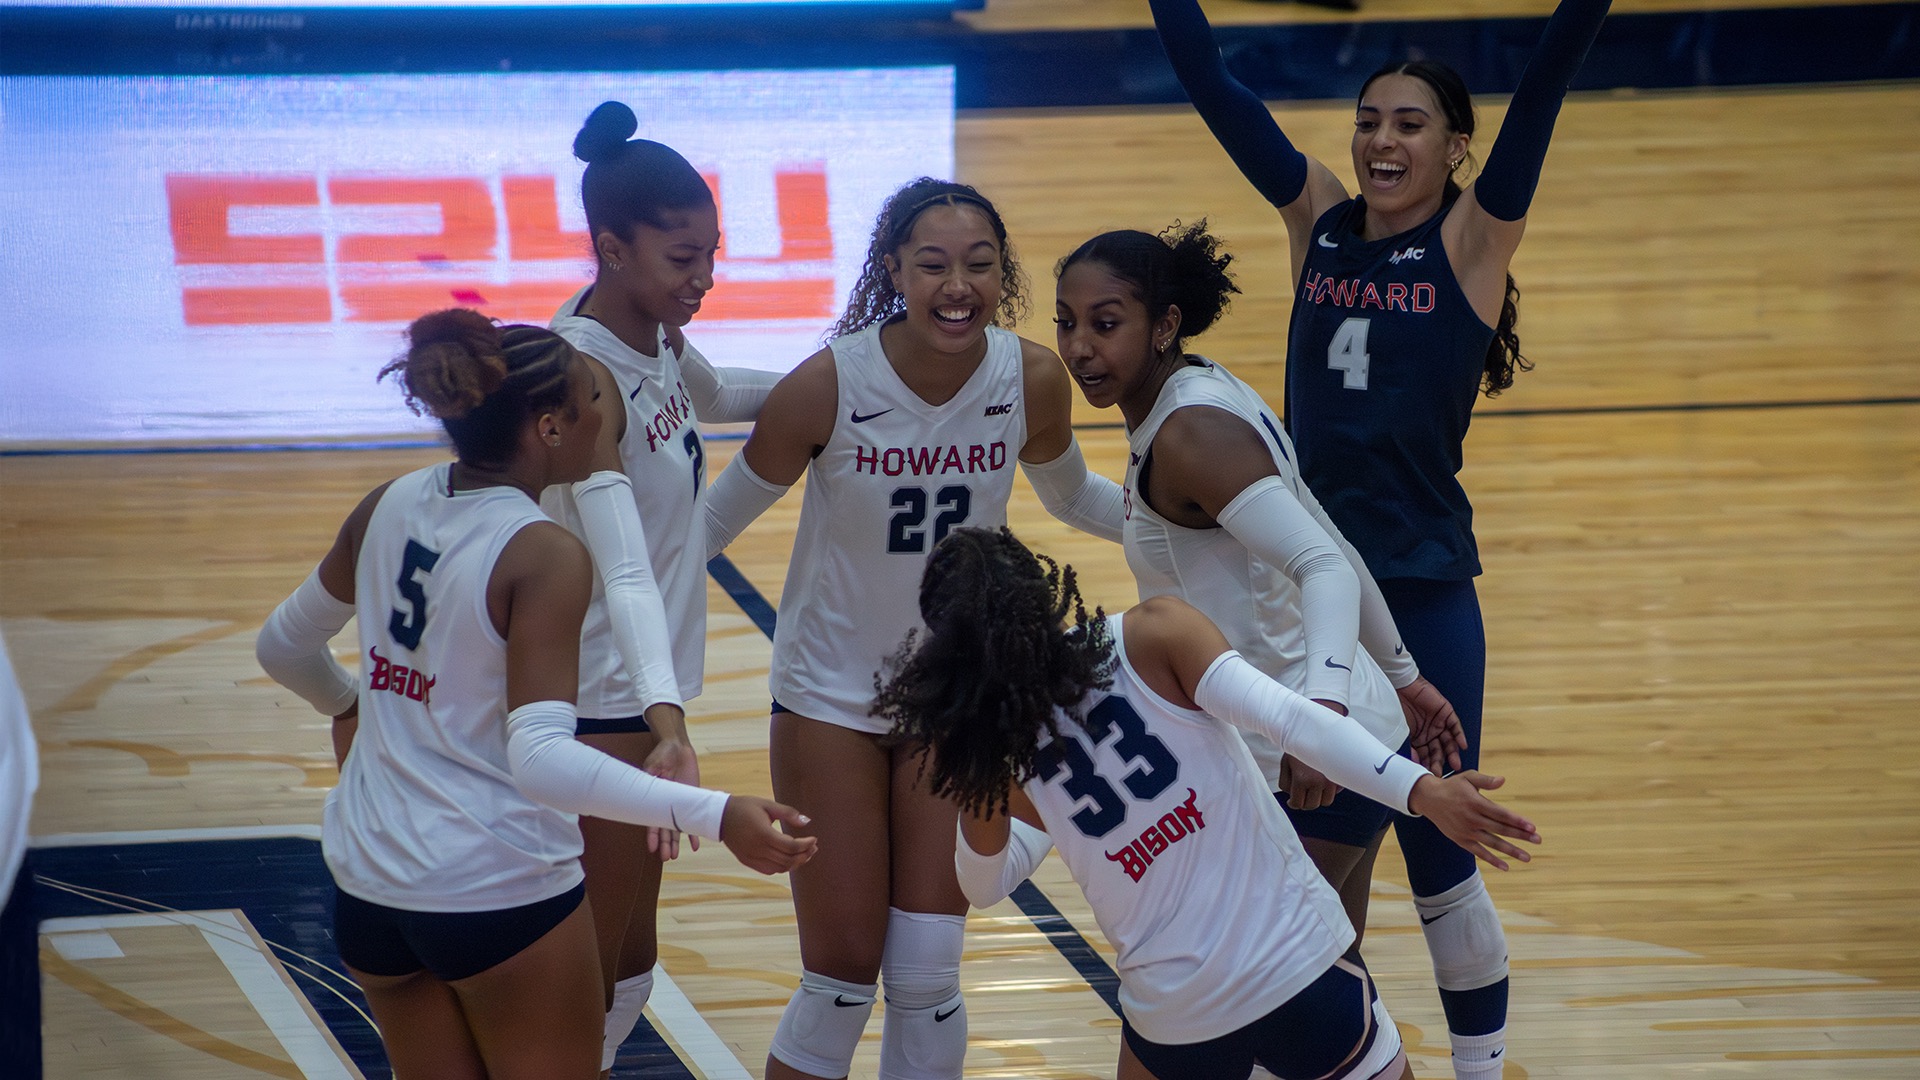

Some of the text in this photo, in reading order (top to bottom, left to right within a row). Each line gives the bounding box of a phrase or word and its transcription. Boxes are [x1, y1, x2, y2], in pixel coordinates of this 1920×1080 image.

[1302, 268, 1436, 313] HOWARD
[1388, 247, 1426, 265] MAC
[1327, 317, 1371, 391] 4
[645, 380, 690, 453] HOWA
[856, 440, 1006, 476] HOWARD
[886, 484, 973, 555] 22
[388, 537, 441, 651] 5
[369, 645, 436, 706] BSON
[1030, 693, 1182, 840] 33
[1105, 787, 1206, 883] BISON
